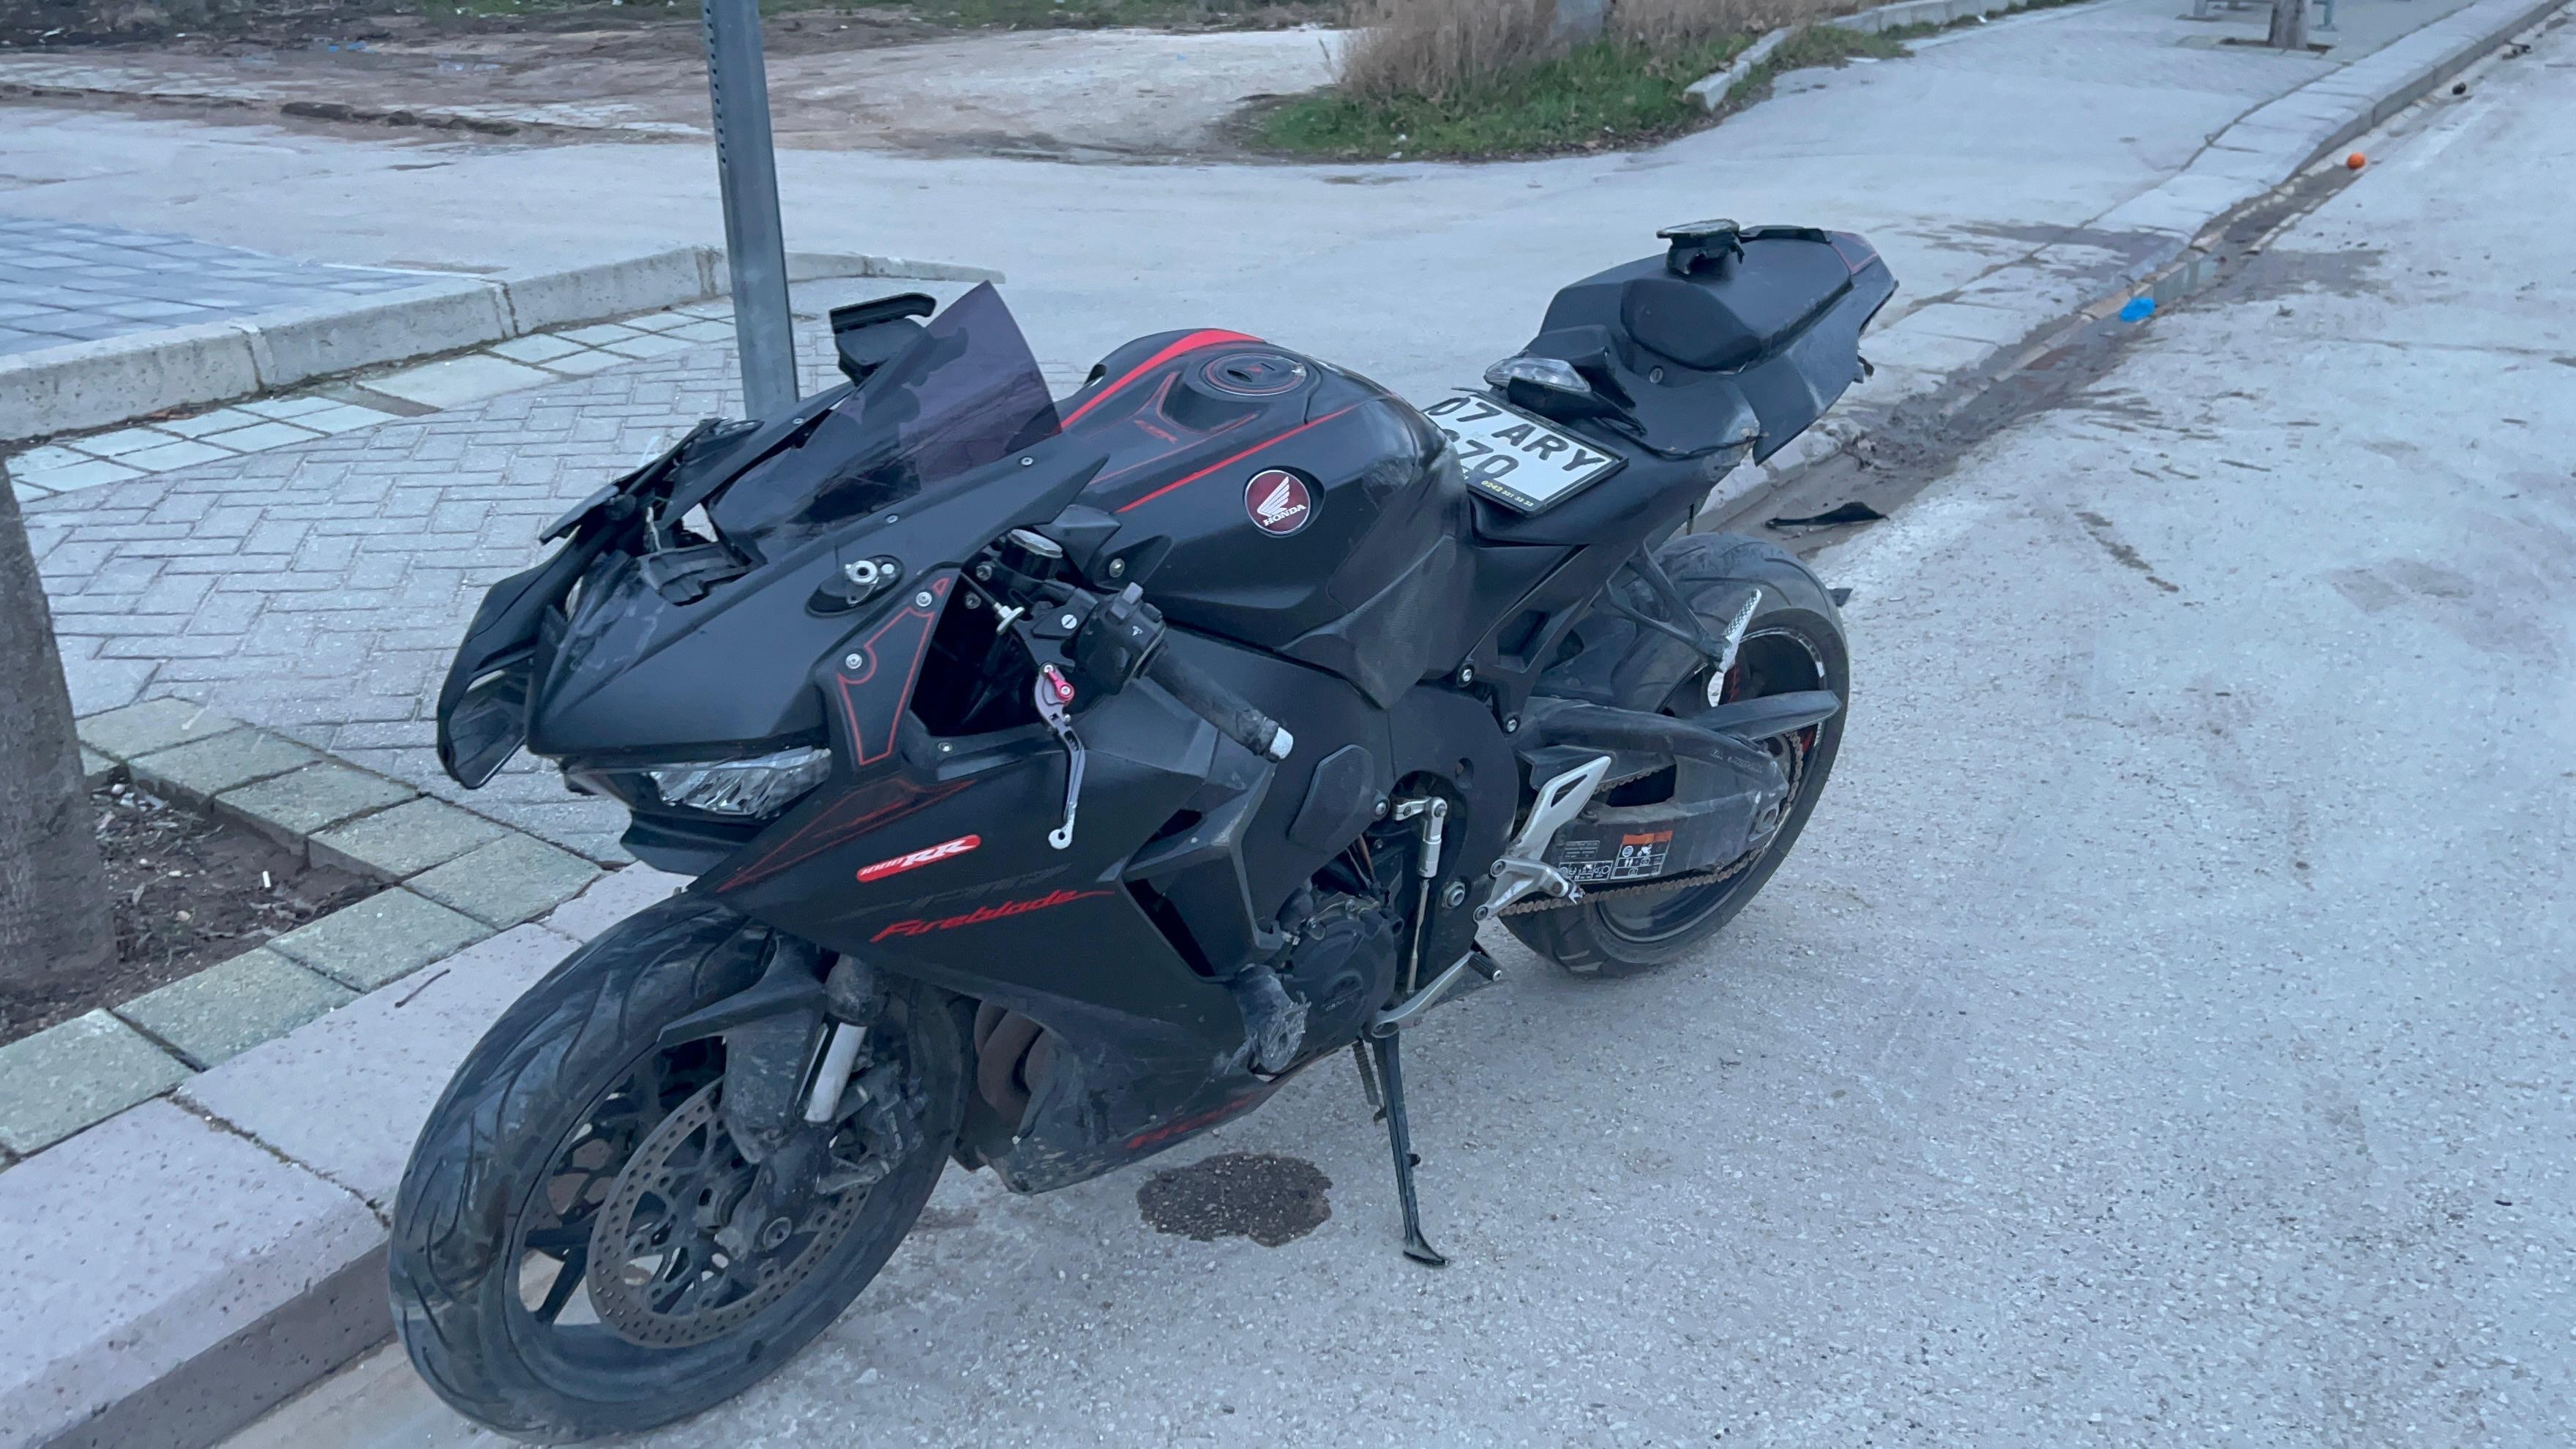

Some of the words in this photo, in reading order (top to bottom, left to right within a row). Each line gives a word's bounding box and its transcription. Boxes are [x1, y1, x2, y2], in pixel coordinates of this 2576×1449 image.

[1427, 397, 1503, 422] 07
[1491, 423, 1606, 472] ARY
[1262, 504, 1307, 526] HONDA
[870, 889, 1115, 943] Fireblade
